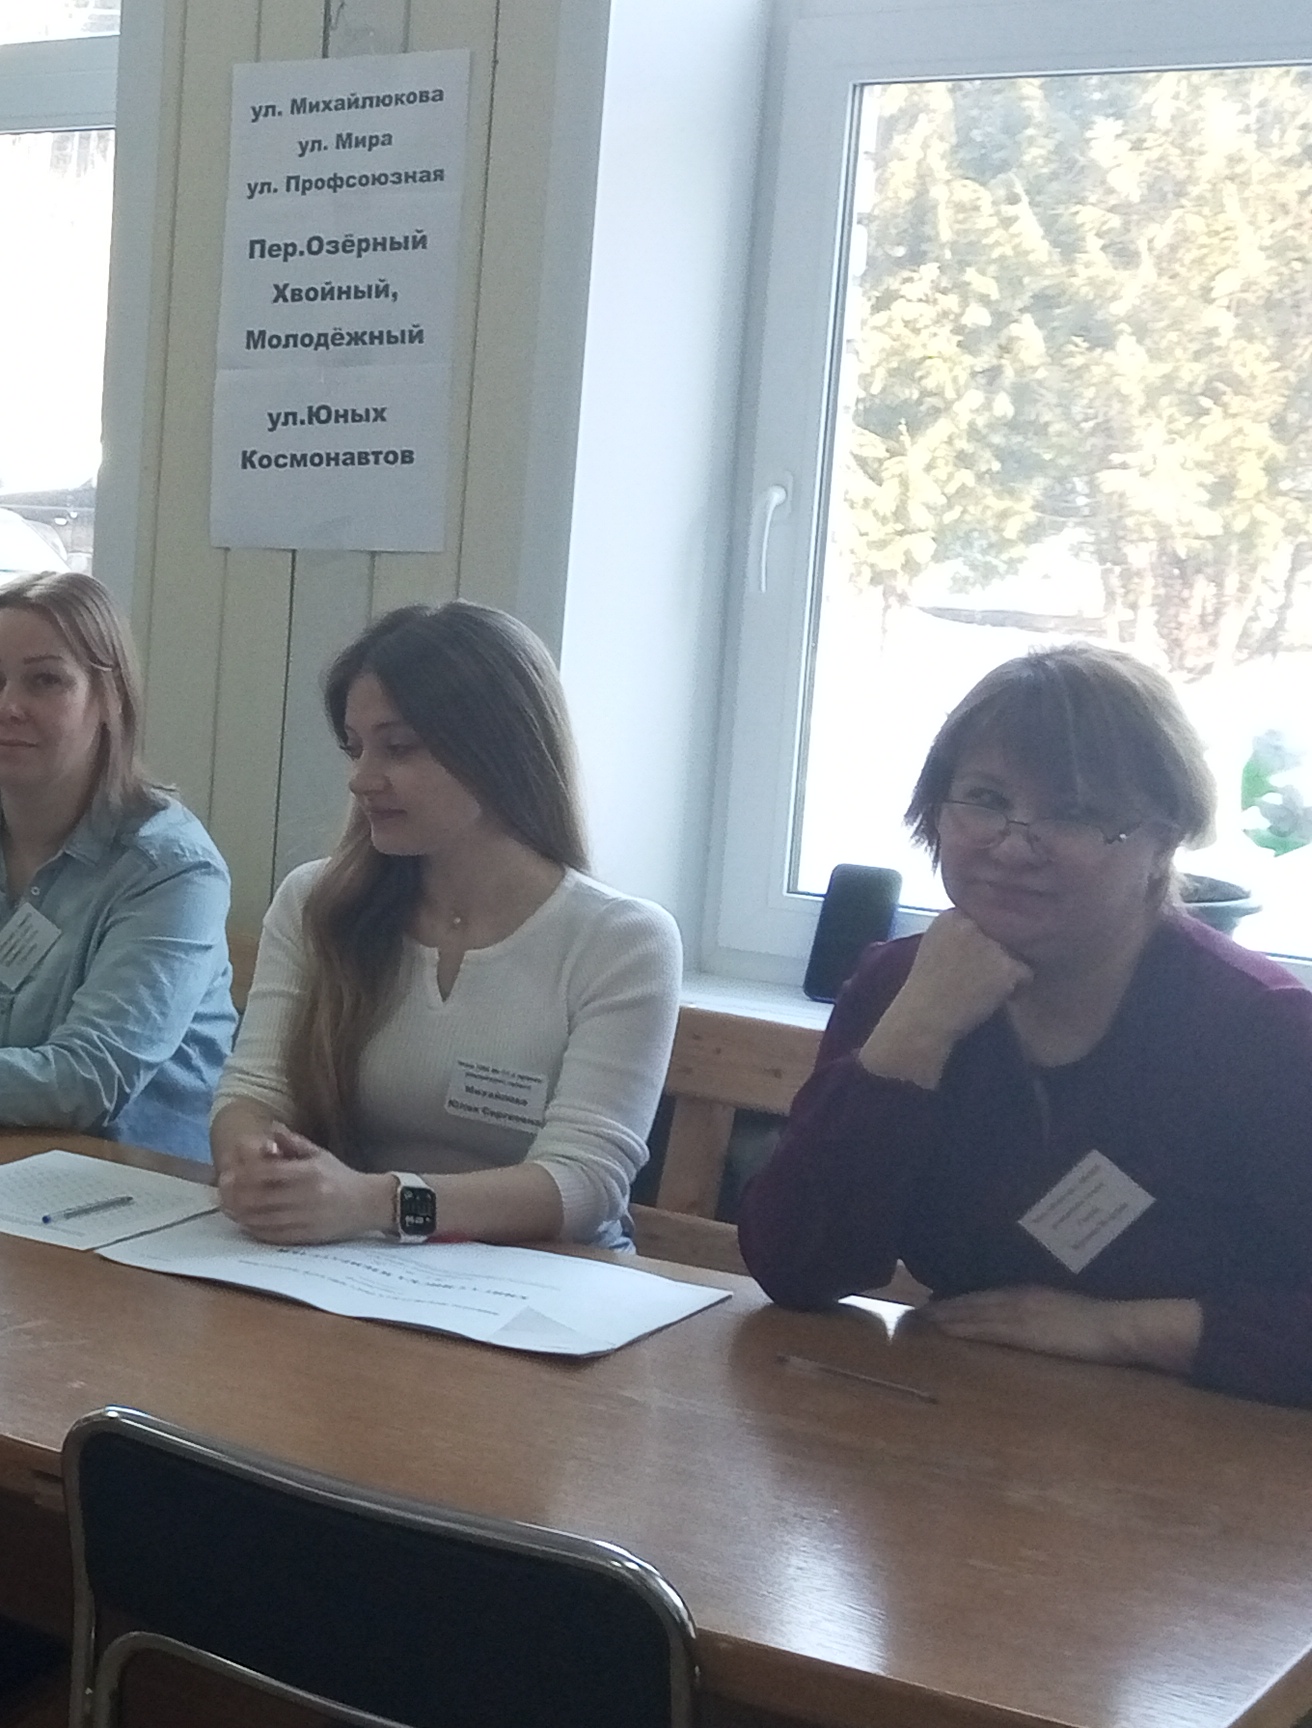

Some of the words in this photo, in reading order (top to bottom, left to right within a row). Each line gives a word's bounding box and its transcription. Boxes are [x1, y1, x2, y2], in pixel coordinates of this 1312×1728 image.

[250, 104, 283, 123] ул.
[290, 88, 445, 116] Михайлюкова
[298, 139, 328, 157] ул.
[335, 132, 393, 152] Мира
[247, 181, 278, 199] ул.
[285, 168, 445, 195] Профсоюзная
[248, 229, 428, 262] Пер.Озёрный
[272, 278, 398, 303] Хвойный,
[245, 323, 425, 351] Молодёжный
[267, 404, 388, 432] ул.Юных
[241, 449, 415, 469] Космонавтов
